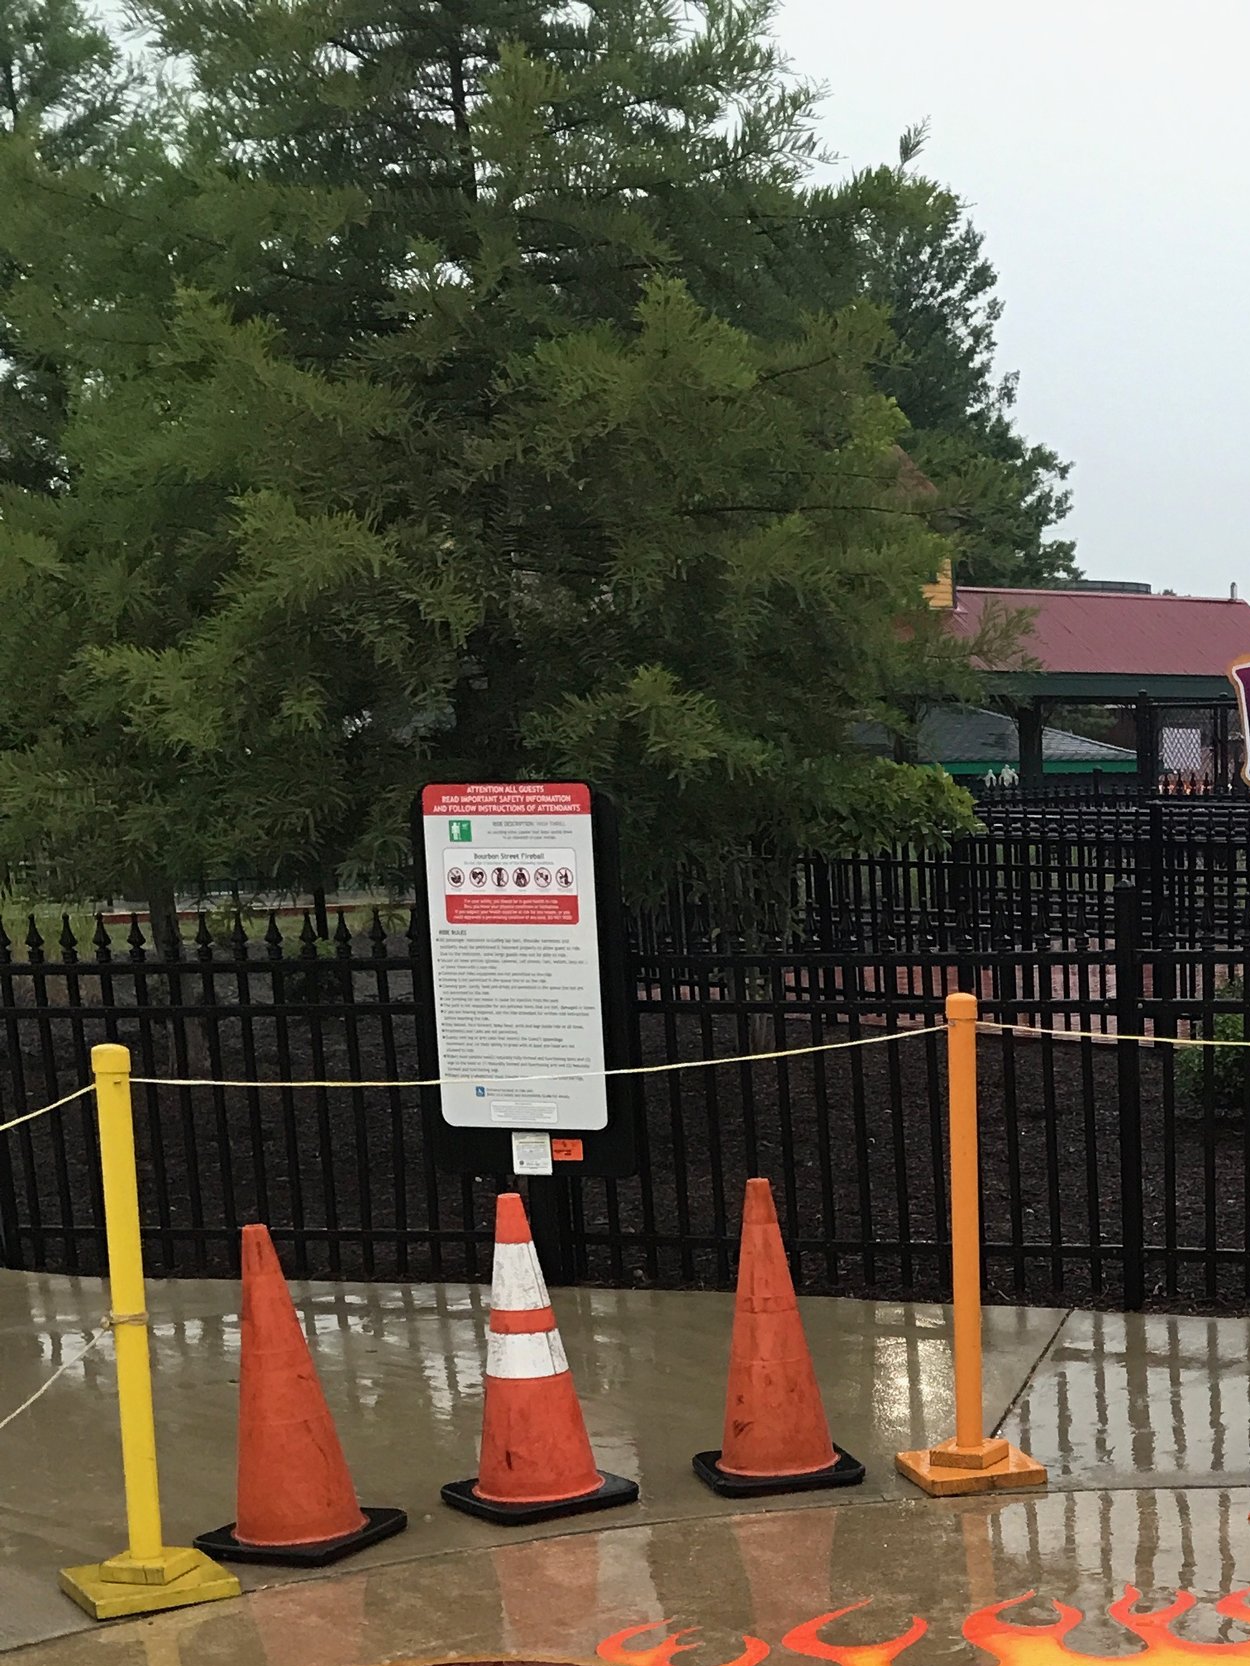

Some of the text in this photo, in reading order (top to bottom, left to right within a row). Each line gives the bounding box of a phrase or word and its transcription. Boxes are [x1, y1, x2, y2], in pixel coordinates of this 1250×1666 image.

[467, 785, 544, 793] ATTENTION ALL GUESTS
[441, 794, 571, 803] READ IMPORTANT SAFETY INFORMATION
[448, 804, 477, 812] FOLLOW
[477, 804, 526, 812] INSTRUCTIONS
[526, 804, 536, 812] OF
[537, 804, 581, 812] ATTENDANTS
